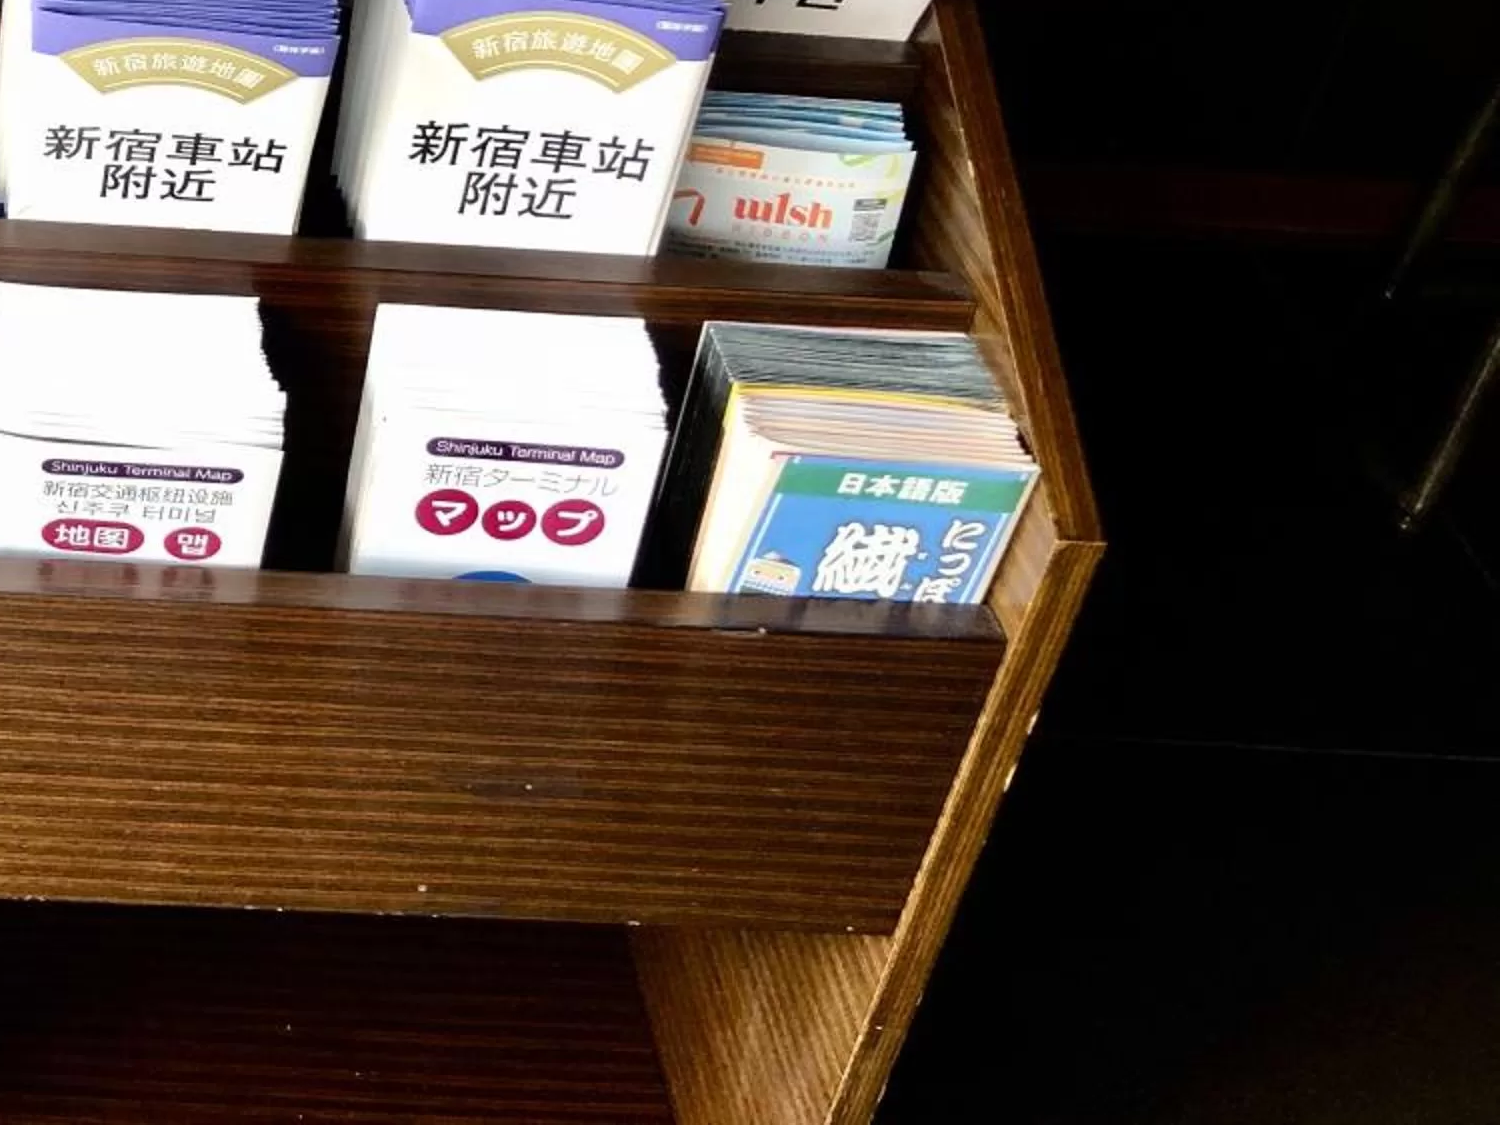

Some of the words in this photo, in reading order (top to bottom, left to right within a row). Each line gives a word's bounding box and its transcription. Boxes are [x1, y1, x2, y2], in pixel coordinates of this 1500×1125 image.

[43, 124, 288, 174] 新宿車站
[408, 120, 655, 182] 新宿車站
[99, 163, 217, 202] 附近
[457, 170, 577, 220] 附近
[436, 440, 503, 457] Shinjuku
[510, 444, 576, 462] Terminal
[579, 450, 616, 466] Map
[51, 460, 118, 475] Shinjuku
[124, 464, 191, 479] Terminal
[195, 468, 233, 482] Map
[425, 464, 618, 497] 新宿ターミナル
[43, 480, 233, 506] 新宿交通枢纽设施
[837, 472, 970, 506] 日本語版
[57, 501, 131, 519] 신주쿠
[142, 505, 216, 524] 터미널
[431, 499, 599, 538] マップ
[53, 524, 129, 549] 地图
